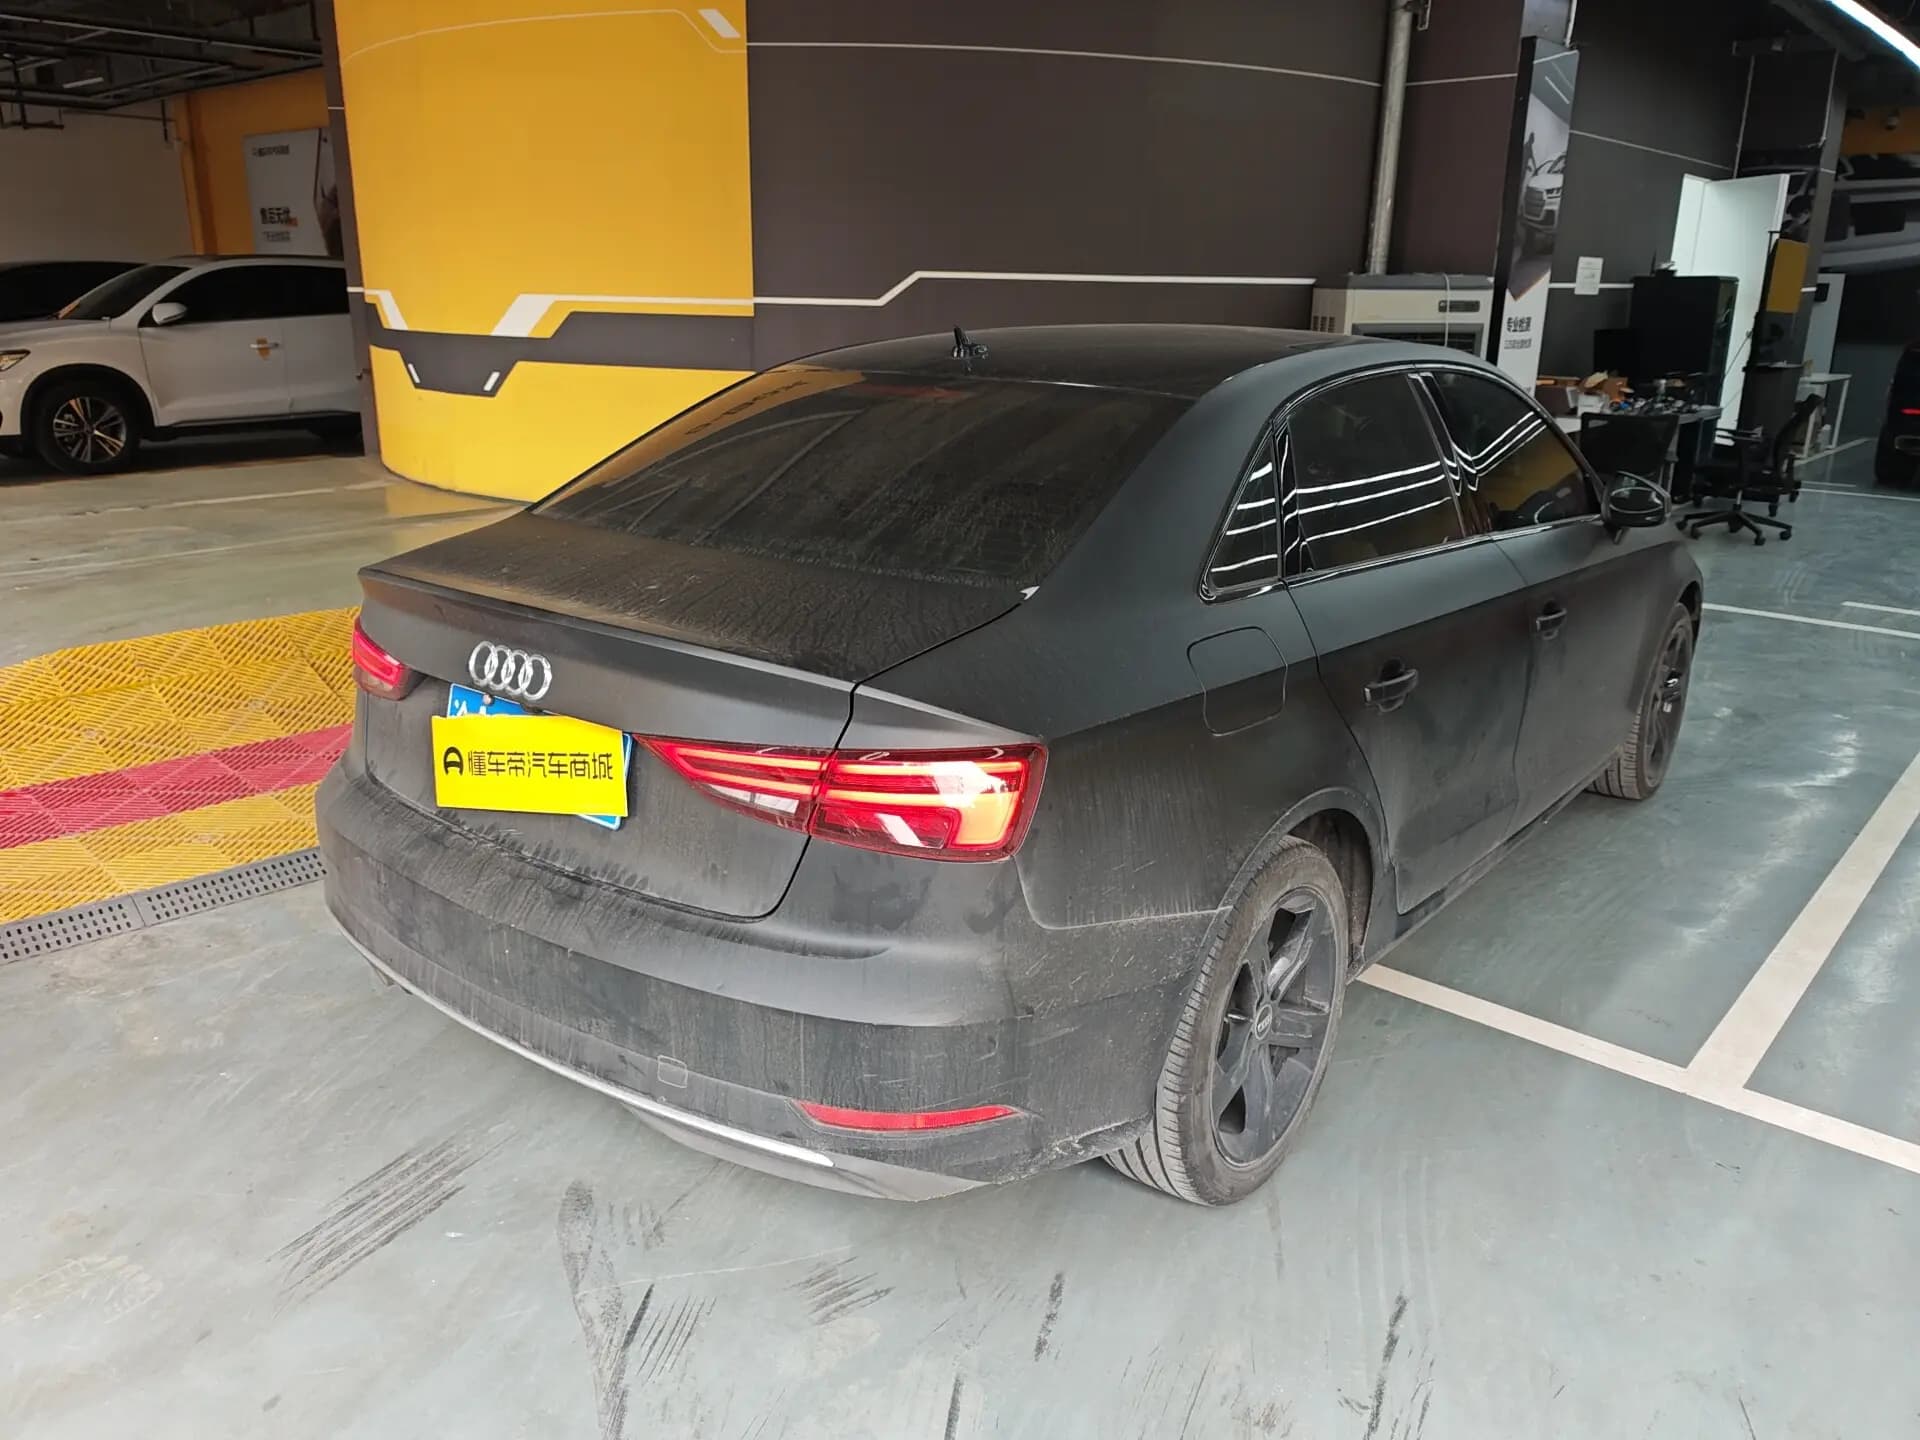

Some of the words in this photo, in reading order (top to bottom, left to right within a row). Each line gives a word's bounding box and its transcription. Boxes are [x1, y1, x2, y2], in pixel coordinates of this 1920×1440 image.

[467, 750, 614, 781] 懂车帝汽车商城
